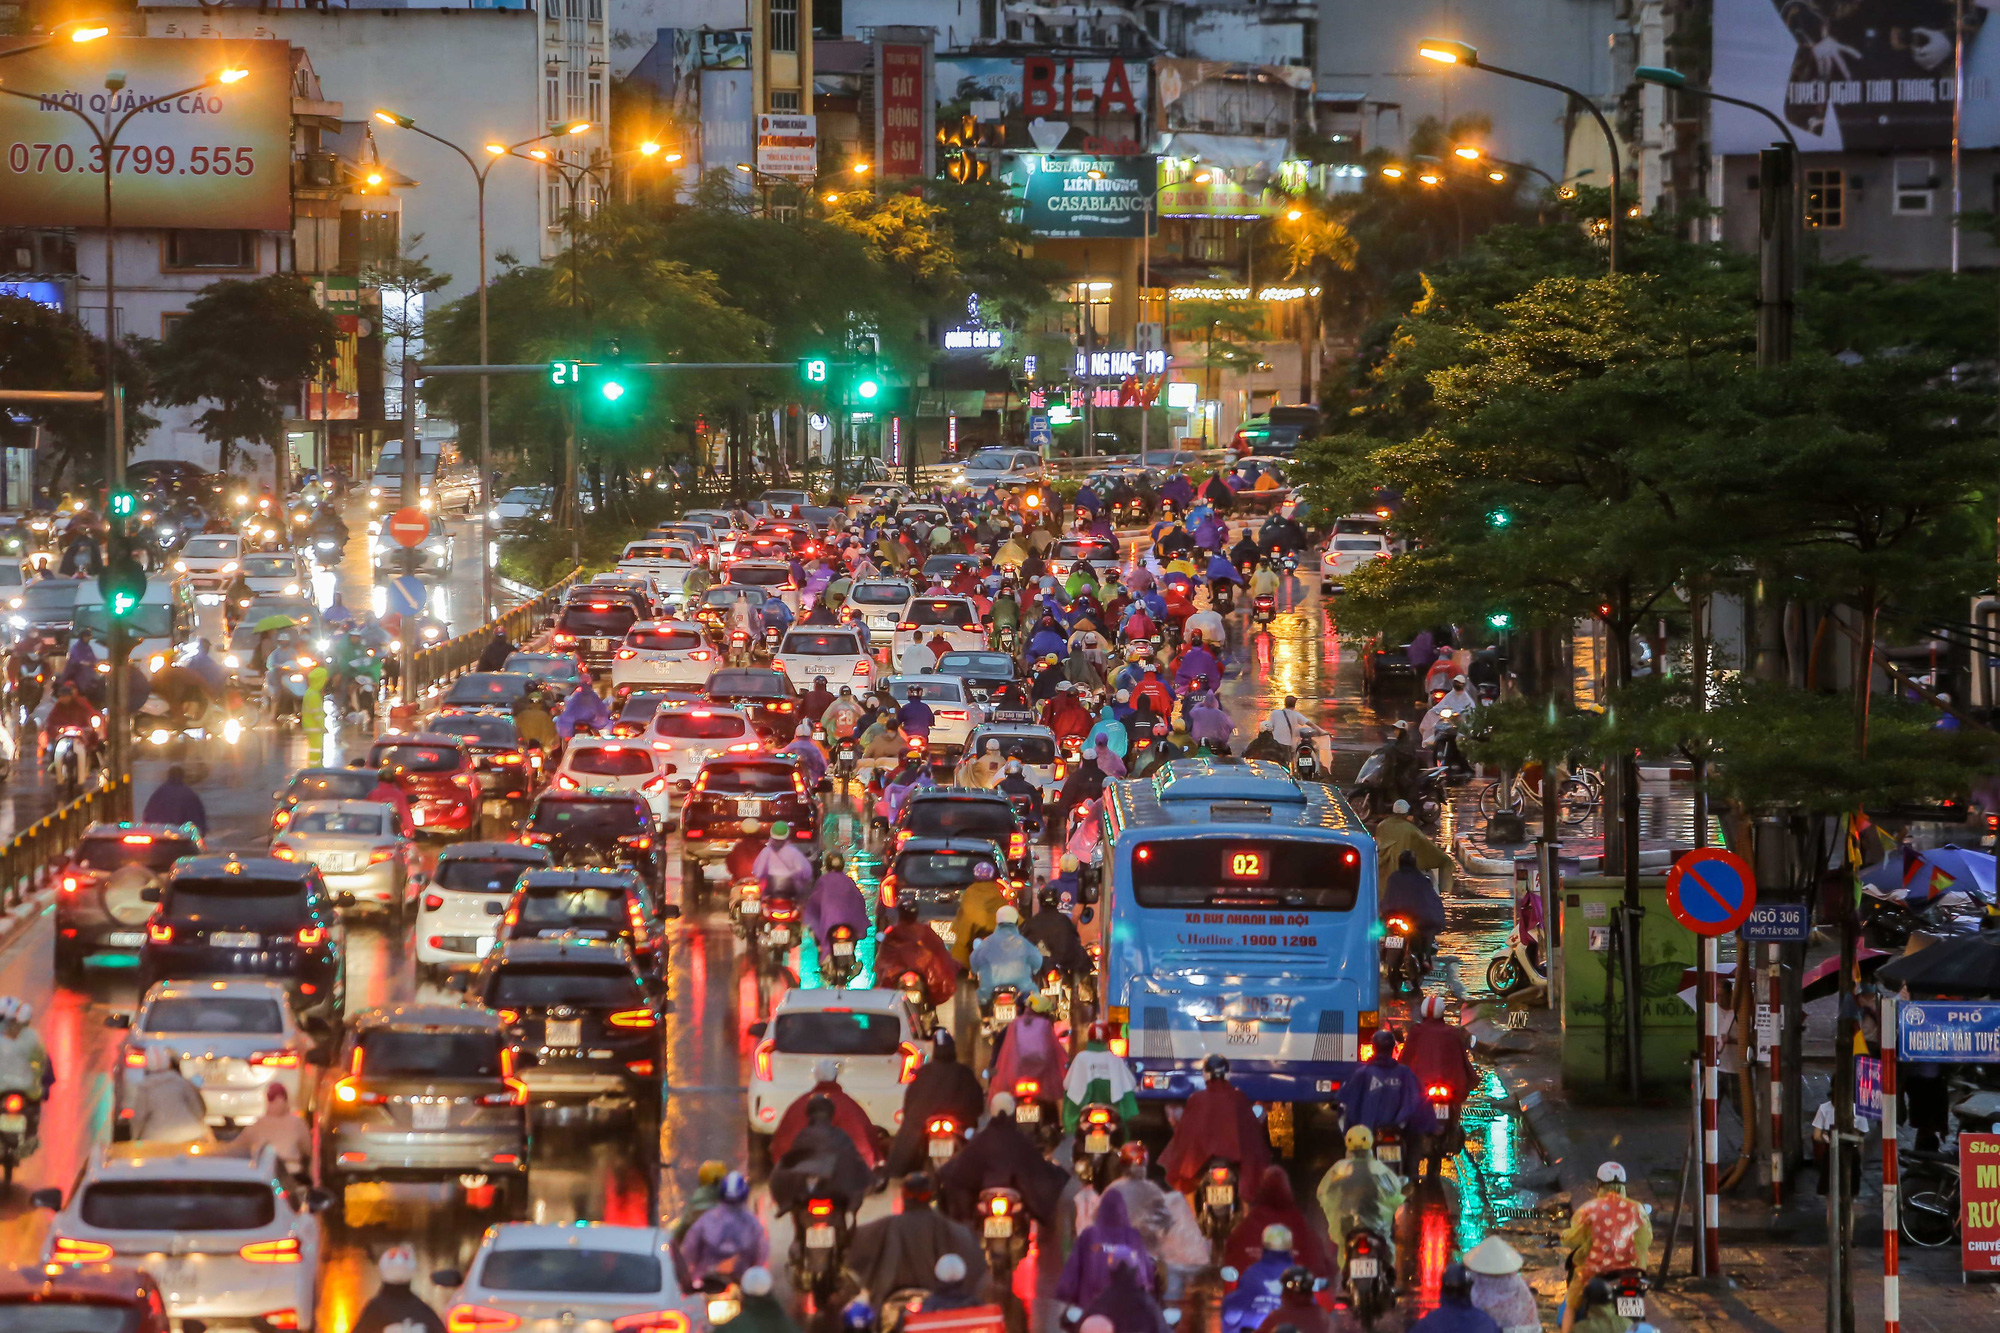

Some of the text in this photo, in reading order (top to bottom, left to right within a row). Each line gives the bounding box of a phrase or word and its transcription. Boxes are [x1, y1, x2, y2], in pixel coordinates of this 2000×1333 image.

[39, 90, 223, 115] MỜI QUẢNG CÁO
[887, 103, 919, 132] ĐỘNG
[891, 133, 916, 161] SẢN
[9, 143, 255, 176] 070.3799.555
[552, 363, 579, 385] 21
[807, 360, 826, 382] 19
[838, 709, 854, 726] 28
[1233, 855, 1259, 875] 02
[1204, 914, 1224, 925] BUS
[1269, 914, 1284, 926] HÀ
[1287, 912, 1309, 928] NỘI
[1749, 908, 1800, 923] NGÕ 306
[1187, 934, 1318, 947] Hotline 1900 1296
[1750, 925, 1799, 935] PHỐ TÂY SƠN
[1948, 1009, 1982, 1022] PHỐ
[1235, 1023, 1251, 1033] 29B
[1909, 1024, 1949, 1051] NGUYỄN
[1952, 1029, 1971, 1051] VĂN
[1970, 1141, 2000, 1155] Sho
[1977, 1165, 2000, 1188] M
[1967, 1199, 2000, 1228] RƯ
